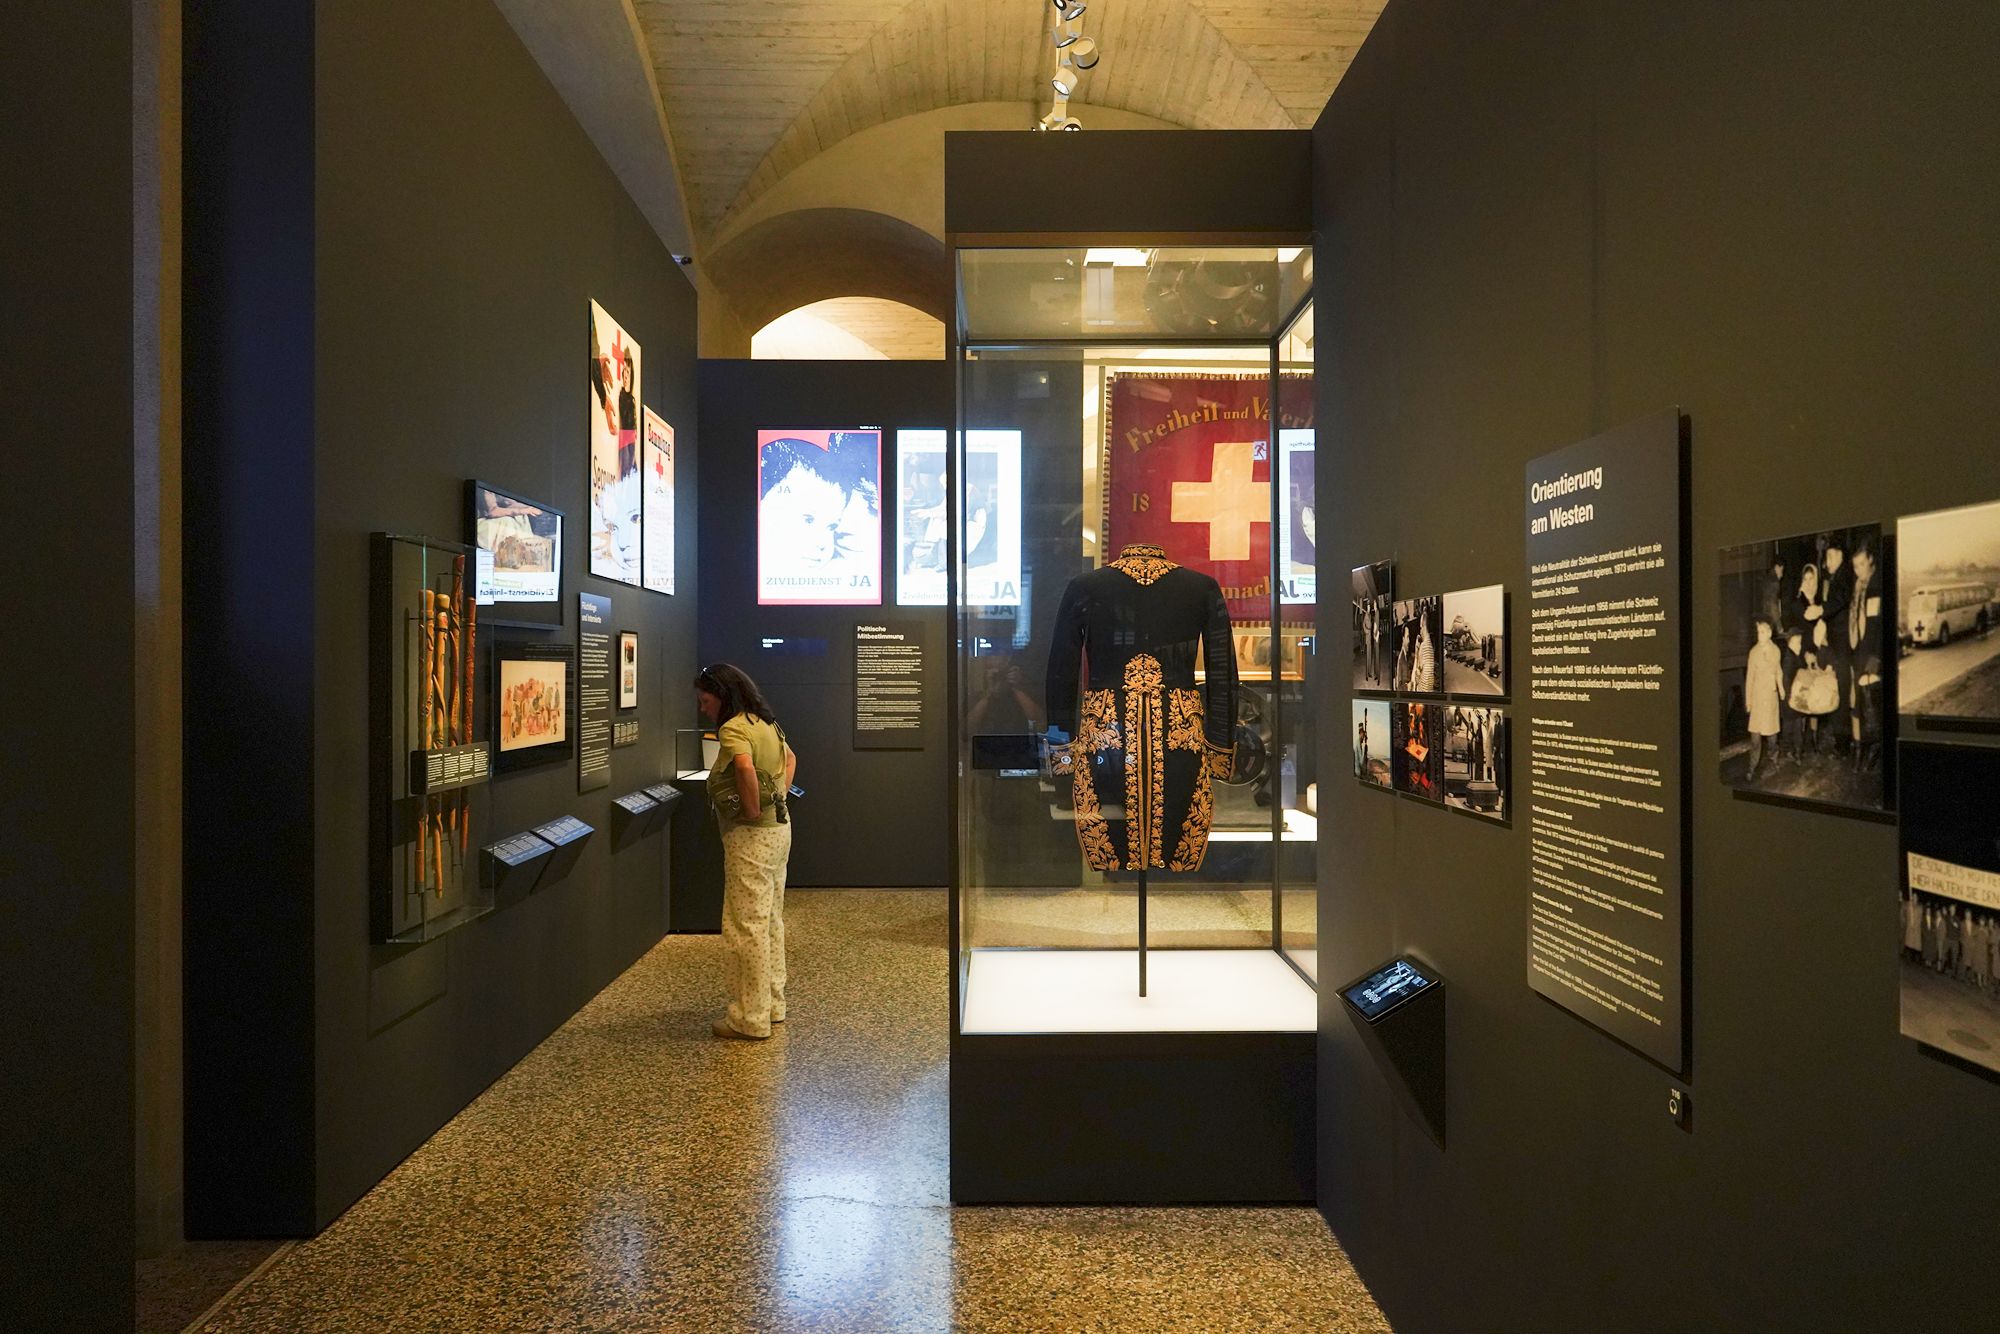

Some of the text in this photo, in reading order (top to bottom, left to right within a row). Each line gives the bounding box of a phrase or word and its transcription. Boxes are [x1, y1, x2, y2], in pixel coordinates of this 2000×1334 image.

[1125, 402, 1219, 453] Freiheit
[1223, 406, 1249, 420] und
[777, 485, 791, 494] JA
[1531, 467, 1602, 503] Orientierung
[1531, 504, 1594, 535] am Westen
[1579, 554, 1598, 565] Schweiz
[1638, 545, 1652, 555] kann
[1653, 543, 1662, 552] sie
[1646, 559, 1655, 569] sie
[1656, 558, 1664, 567] als
[766, 575, 872, 587] ZIVILDIENST JA
[989, 581, 1017, 600] JA
[1626, 599, 1634, 608] die
[1635, 596, 1658, 607] Schweiz
[1631, 612, 1654, 622] Ländern
[857, 633, 904, 641] Mitbestimmung
[1608, 628, 1643, 640] Zugehörigkeit
[1644, 629, 1656, 637] zum
